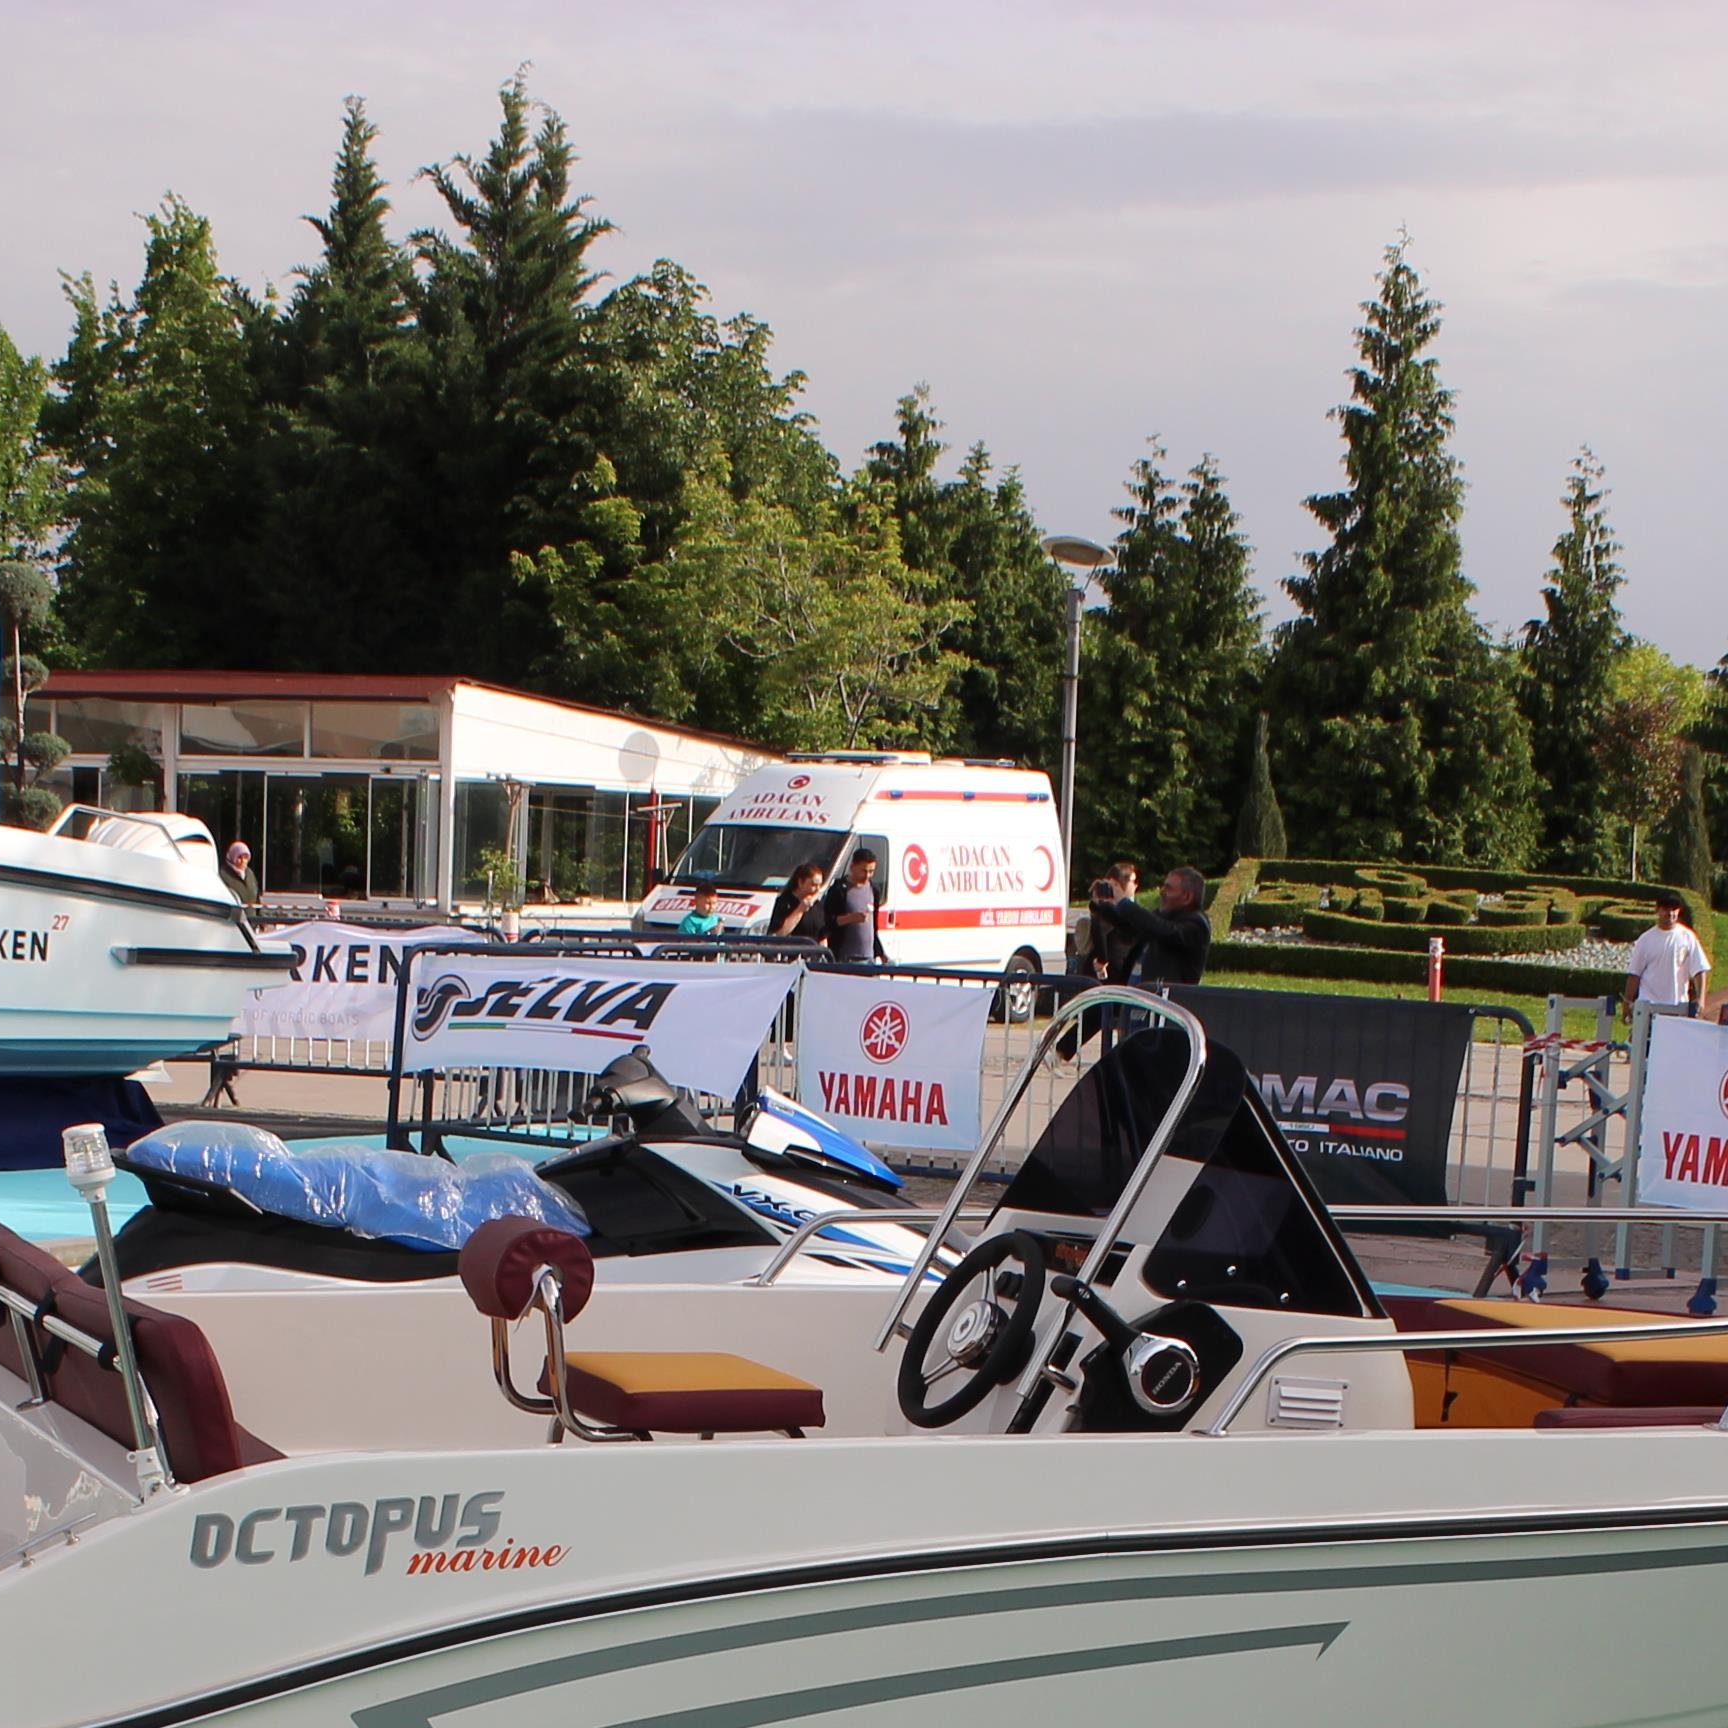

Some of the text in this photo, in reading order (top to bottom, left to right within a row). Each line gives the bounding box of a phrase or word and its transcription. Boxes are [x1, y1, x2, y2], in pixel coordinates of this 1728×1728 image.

[726, 807, 830, 825] AMBULANS
[936, 871, 1024, 893] AMBULANS
[52, 915, 70, 930] 27
[289, 944, 411, 984] RKEN
[451, 976, 679, 1031] SELVA
[818, 1071, 950, 1126] YAMAHA
[1261, 1073, 1410, 1122] MAC
[1320, 1140, 1404, 1162] ITALIANO
[1151, 1361, 1183, 1396] HONDA
[190, 1490, 572, 1577] OCTOPUS marine
